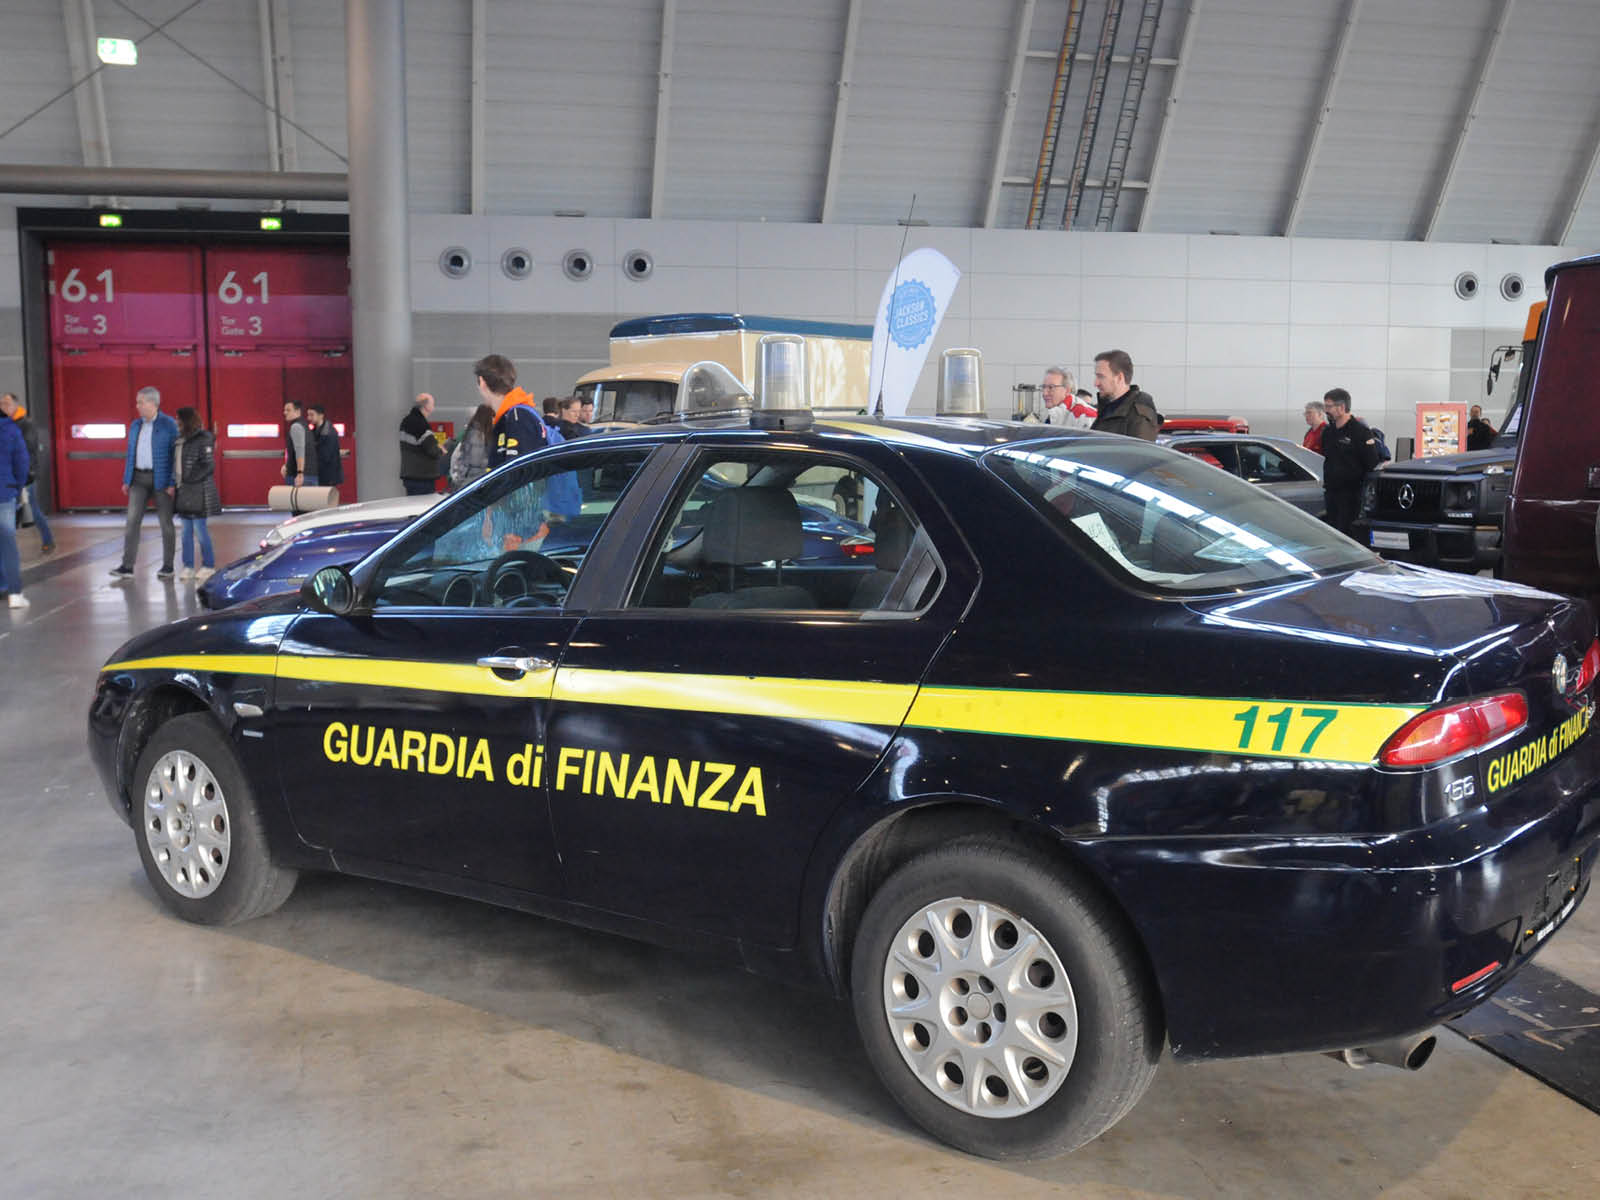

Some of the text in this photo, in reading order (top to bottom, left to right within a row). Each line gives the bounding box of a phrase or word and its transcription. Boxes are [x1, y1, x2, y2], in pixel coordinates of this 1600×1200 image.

[62, 269, 114, 303] 6.1
[218, 271, 269, 305] 6.1
[94, 314, 107, 335] 3
[249, 316, 262, 336] 3
[1234, 705, 1339, 754] 117
[323, 721, 767, 817] GUARDIA di FINANZA
[1487, 735, 1547, 793] GUARDIA
[1548, 727, 1559, 760] di
[1443, 775, 1474, 801] 156
